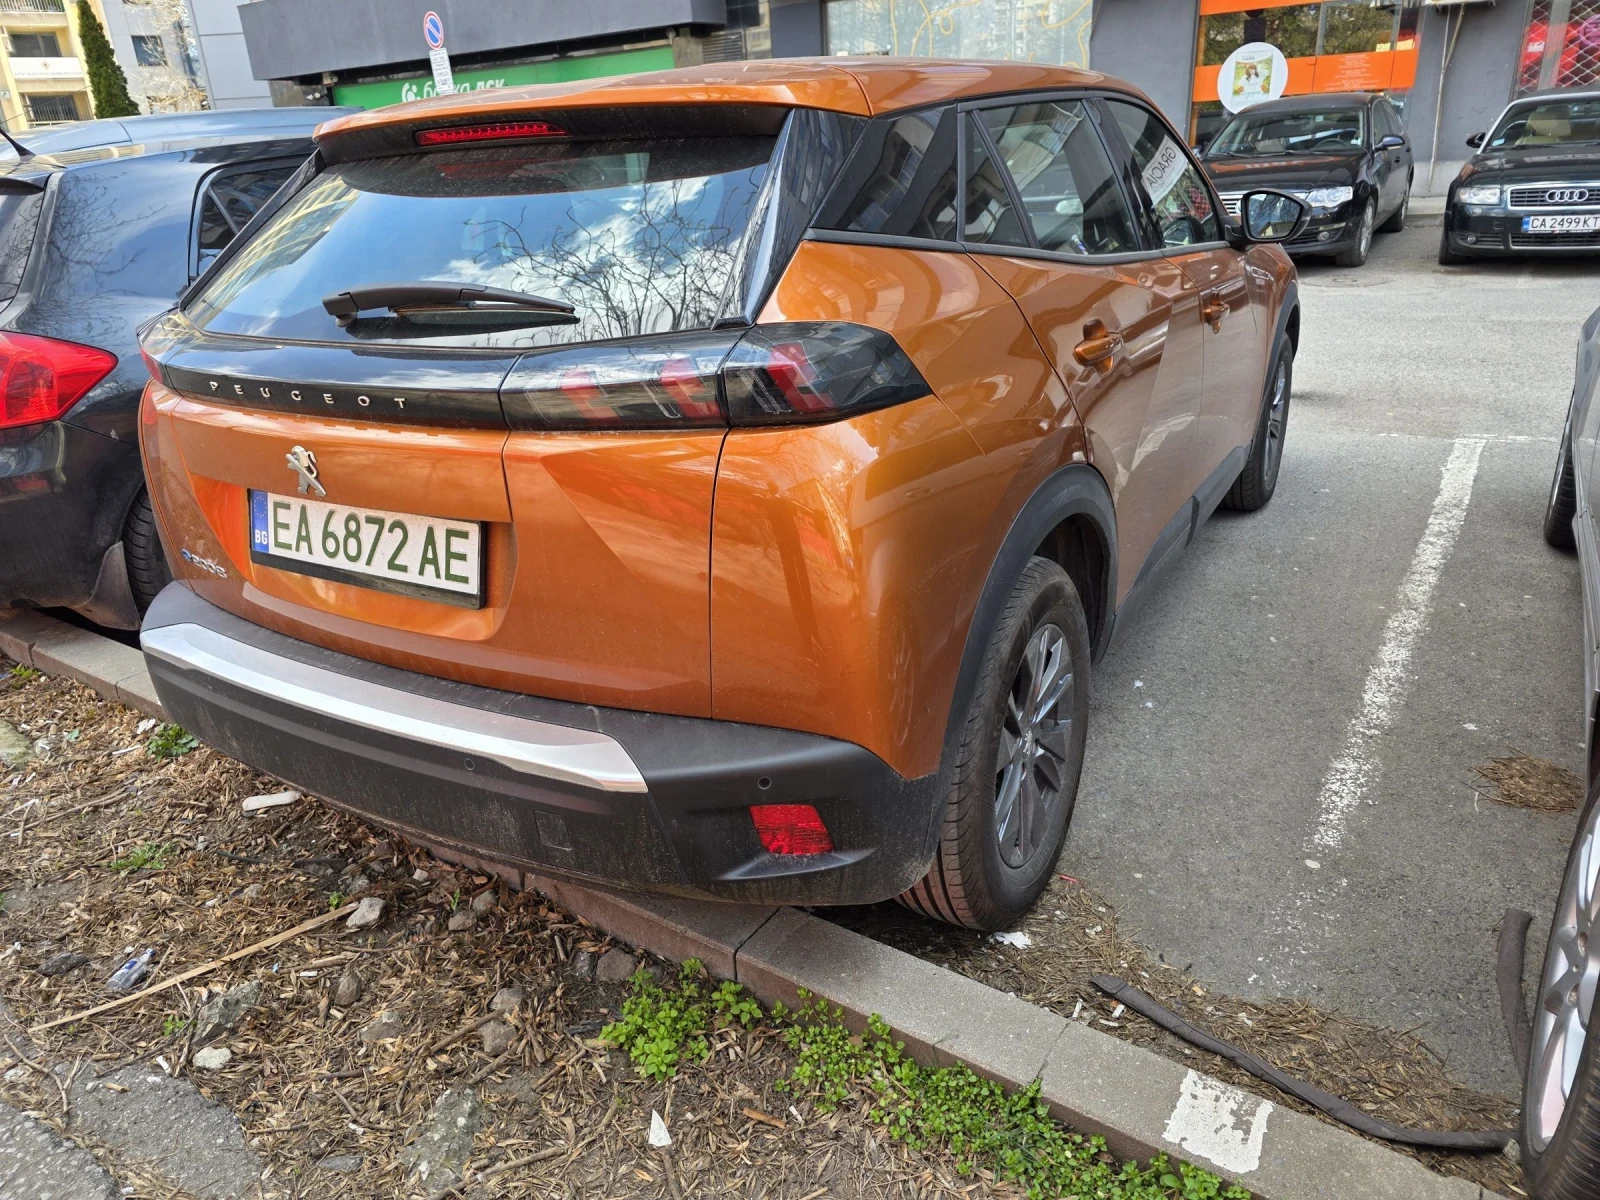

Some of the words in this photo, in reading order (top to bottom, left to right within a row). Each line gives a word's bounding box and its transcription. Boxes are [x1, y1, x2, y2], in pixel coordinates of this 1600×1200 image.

[1531, 217, 1547, 229] CA
[1550, 217, 1581, 229] 2499
[1583, 216, 1600, 228] KT
[209, 381, 406, 409] PEUGEOT
[254, 529, 268, 545] BG
[273, 500, 313, 555] EA
[321, 508, 409, 573] 6872
[418, 526, 470, 584] AE
